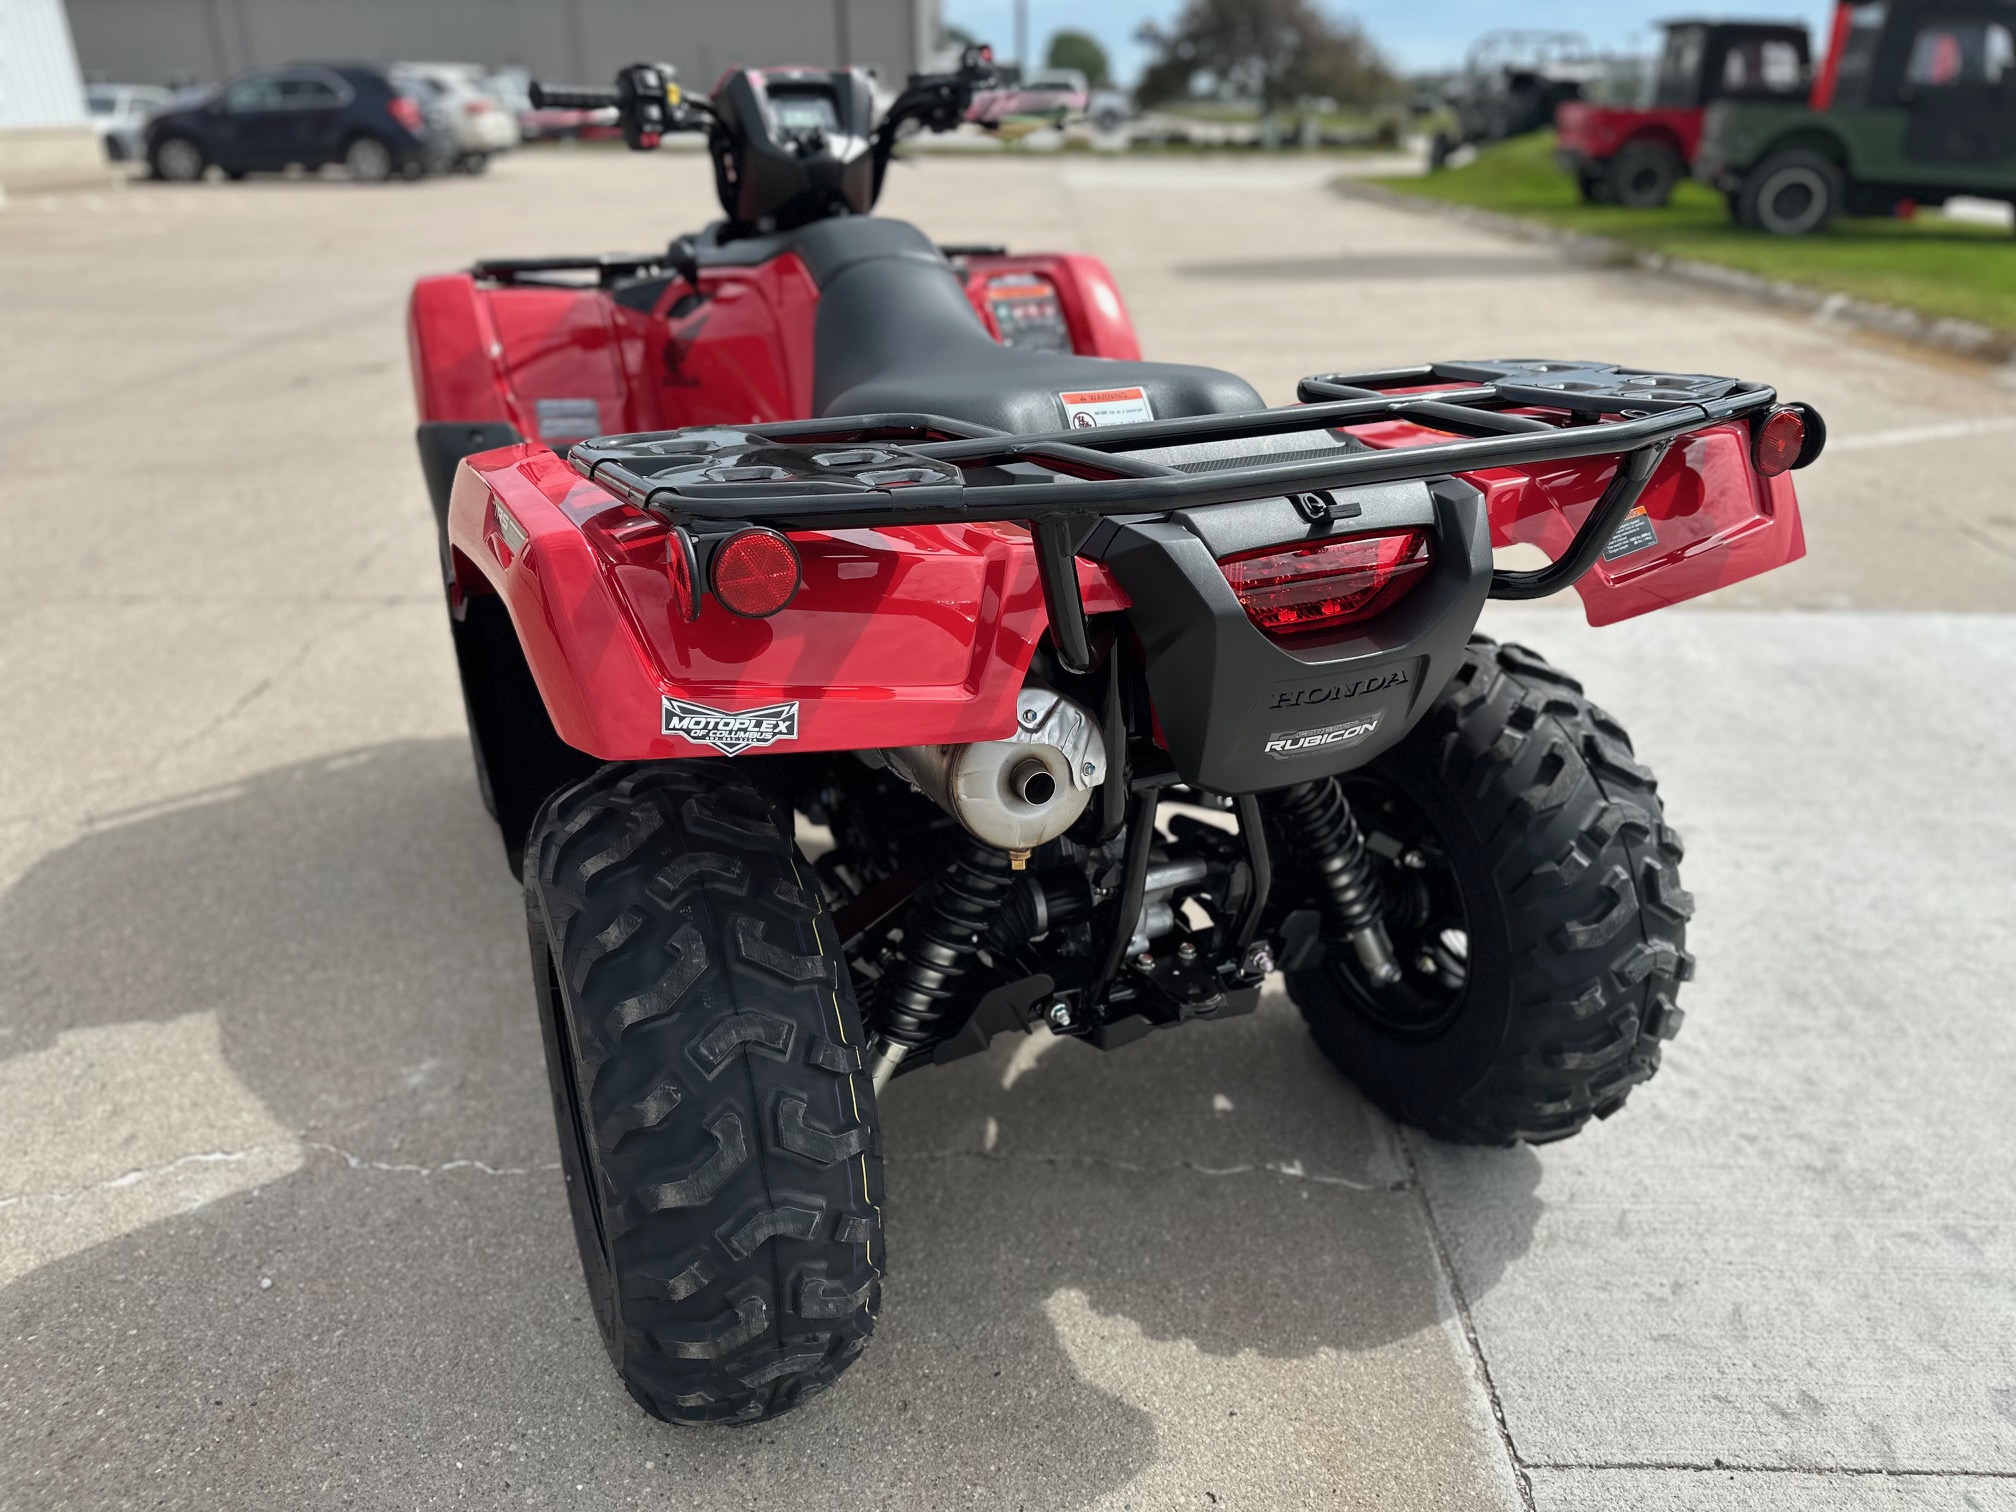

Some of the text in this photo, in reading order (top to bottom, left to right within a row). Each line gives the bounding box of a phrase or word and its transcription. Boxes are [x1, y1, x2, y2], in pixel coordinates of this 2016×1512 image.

[1088, 391, 1128, 402] WARNING
[1268, 670, 1409, 710] HONDA
[668, 716, 792, 733] MOTOPLEX
[690, 729, 774, 739] OF COLUMBUS
[1264, 720, 1378, 752] RUBICON
